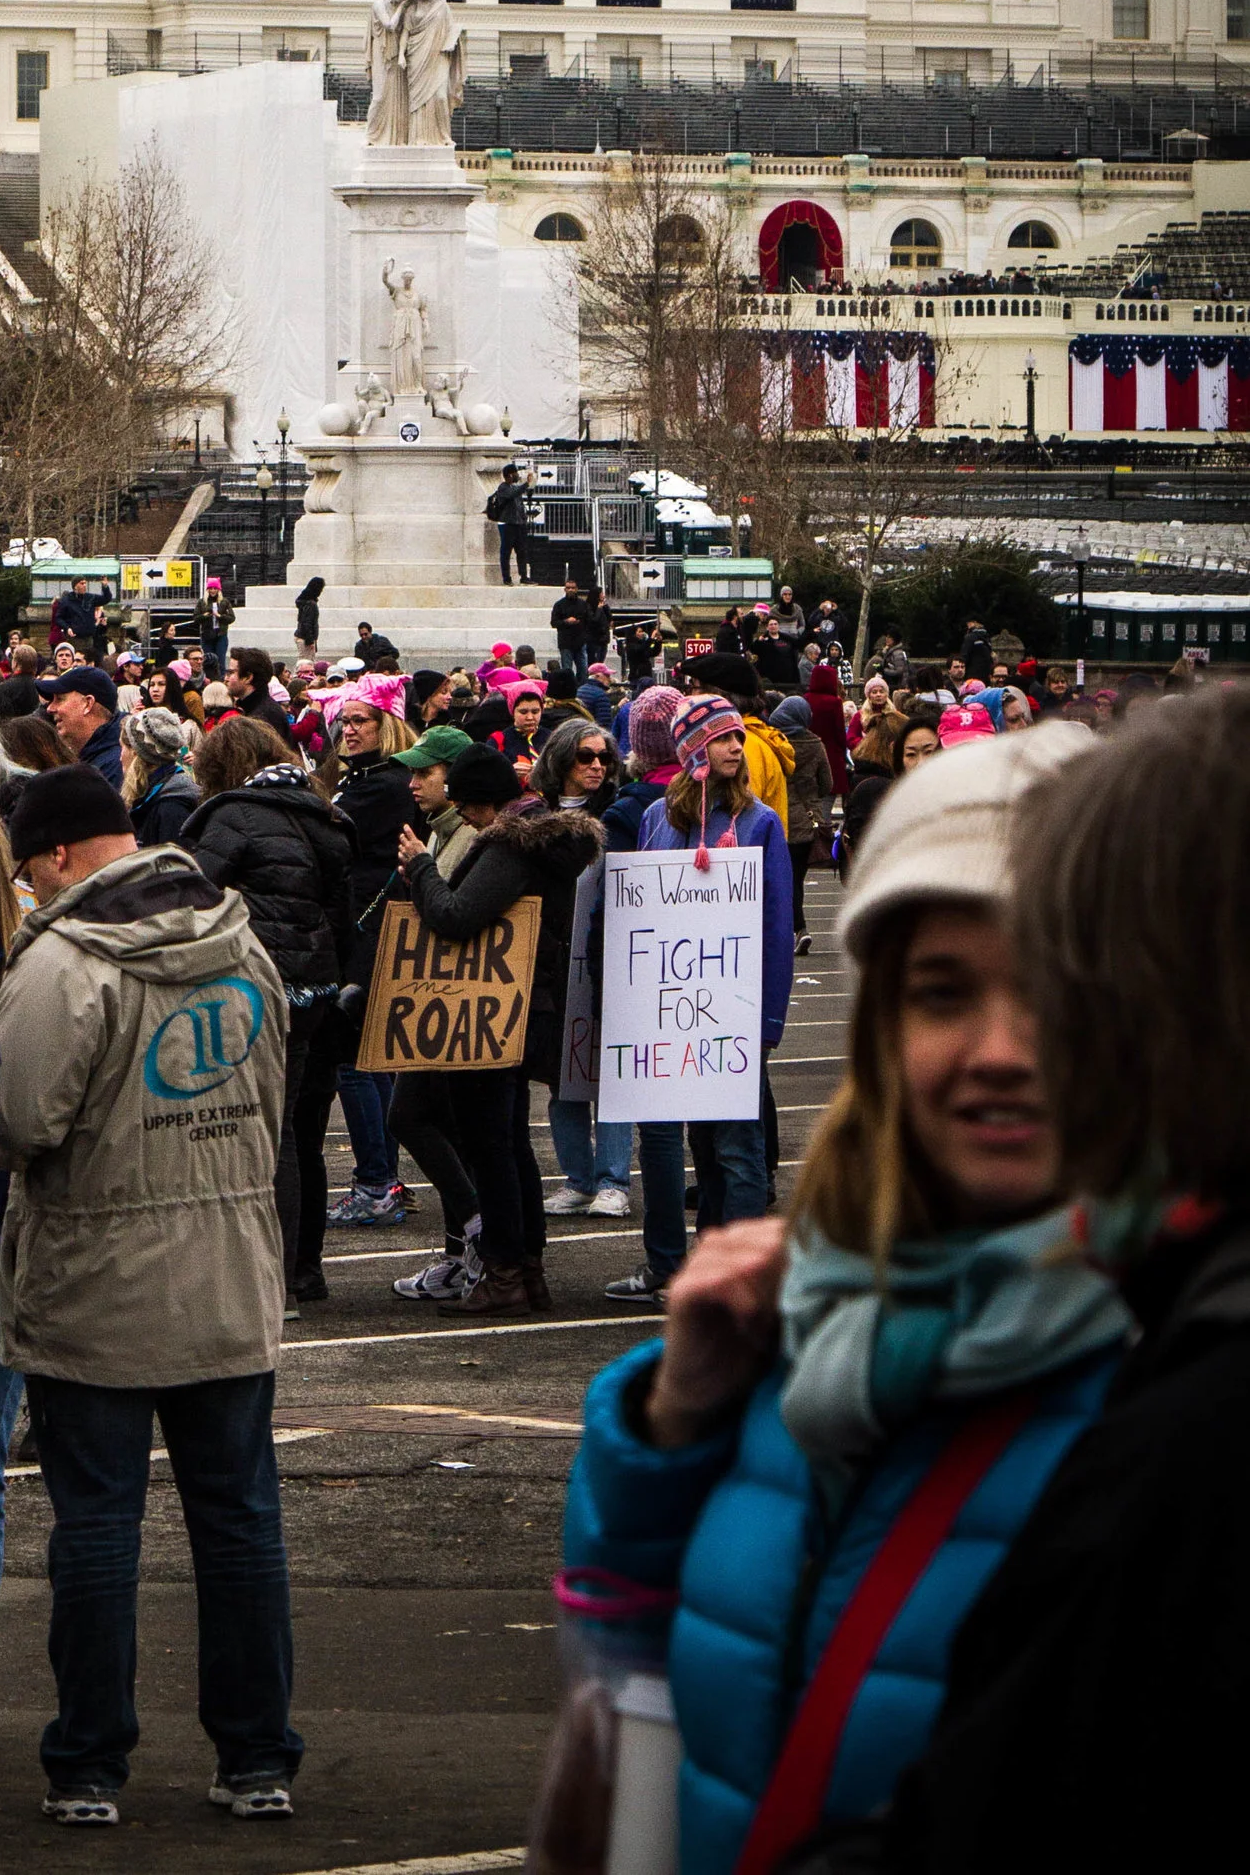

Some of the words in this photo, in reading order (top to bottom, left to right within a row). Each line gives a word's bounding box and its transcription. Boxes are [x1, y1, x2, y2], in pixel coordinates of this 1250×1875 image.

[687, 644, 712, 654] STOP
[959, 712, 973, 727] B
[609, 868, 645, 908] This
[658, 865, 720, 905] Woman
[725, 861, 757, 903] Will
[392, 917, 515, 985] HEAR
[629, 928, 751, 986] FIGHT
[398, 981, 464, 995] me
[658, 987, 719, 1031] FOR
[384, 989, 524, 1062] ROAR!
[607, 1042, 672, 1079] THE
[680, 1036, 749, 1077] ARTS
[143, 1111, 195, 1131] UPPER
[189, 1123, 239, 1142] CENTER
